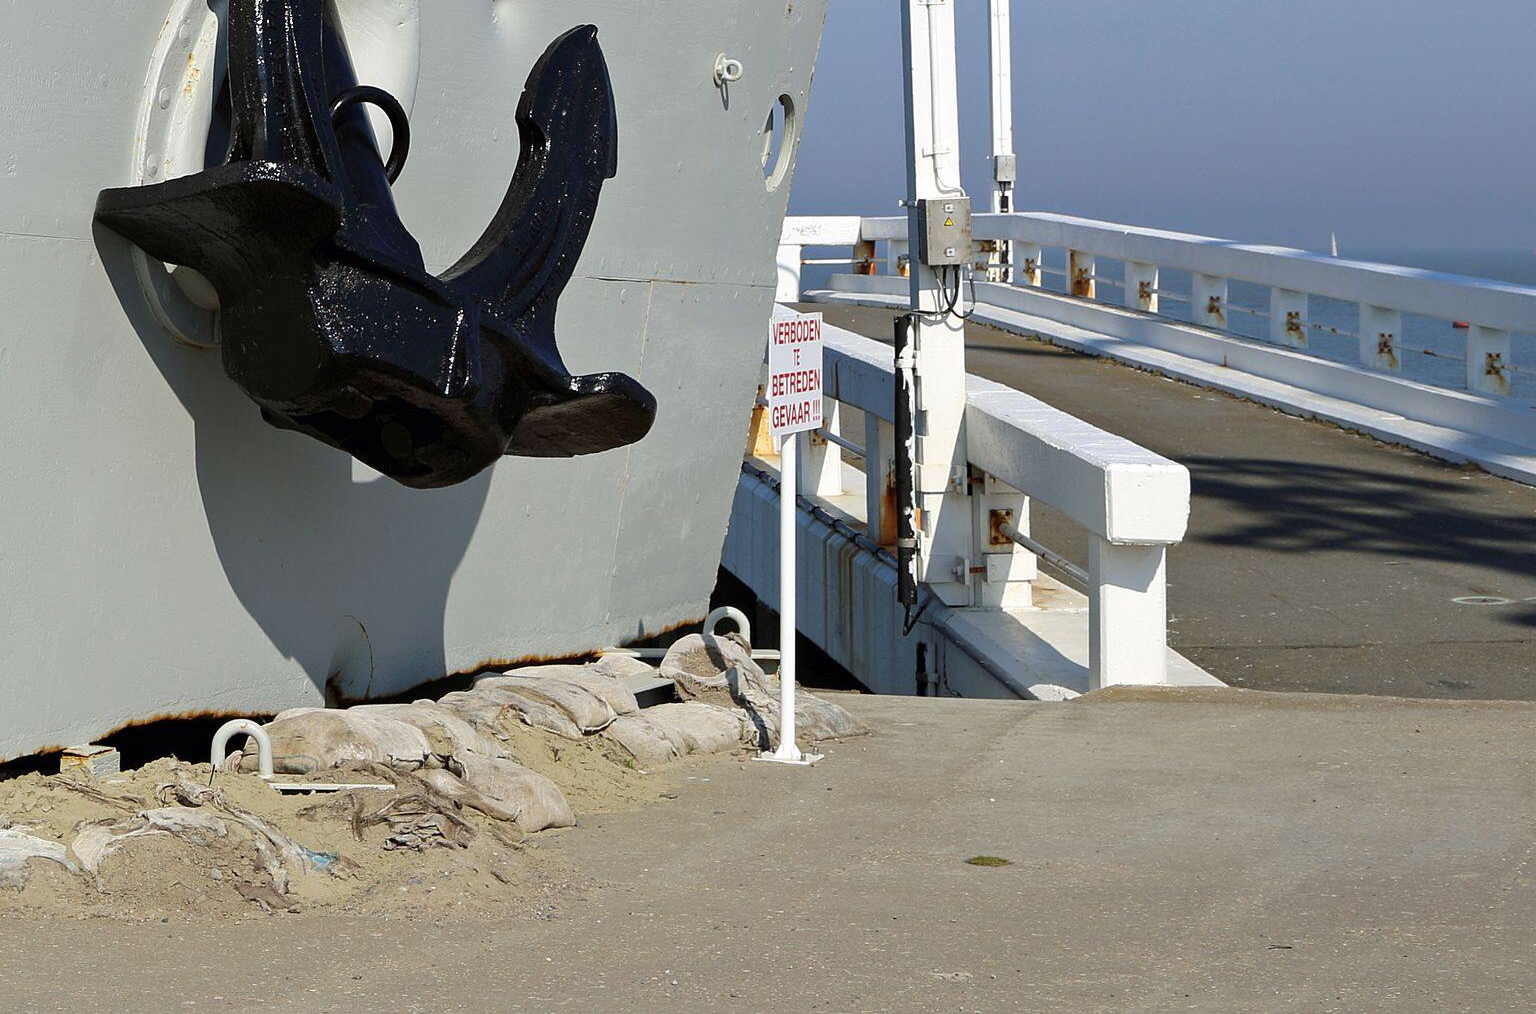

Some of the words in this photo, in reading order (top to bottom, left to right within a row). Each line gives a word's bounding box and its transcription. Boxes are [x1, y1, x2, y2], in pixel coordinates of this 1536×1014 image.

[773, 319, 821, 345] VERBODEN
[793, 348, 800, 366] TE
[772, 369, 820, 397] BETREDEN
[772, 401, 810, 428] GEVAAR
